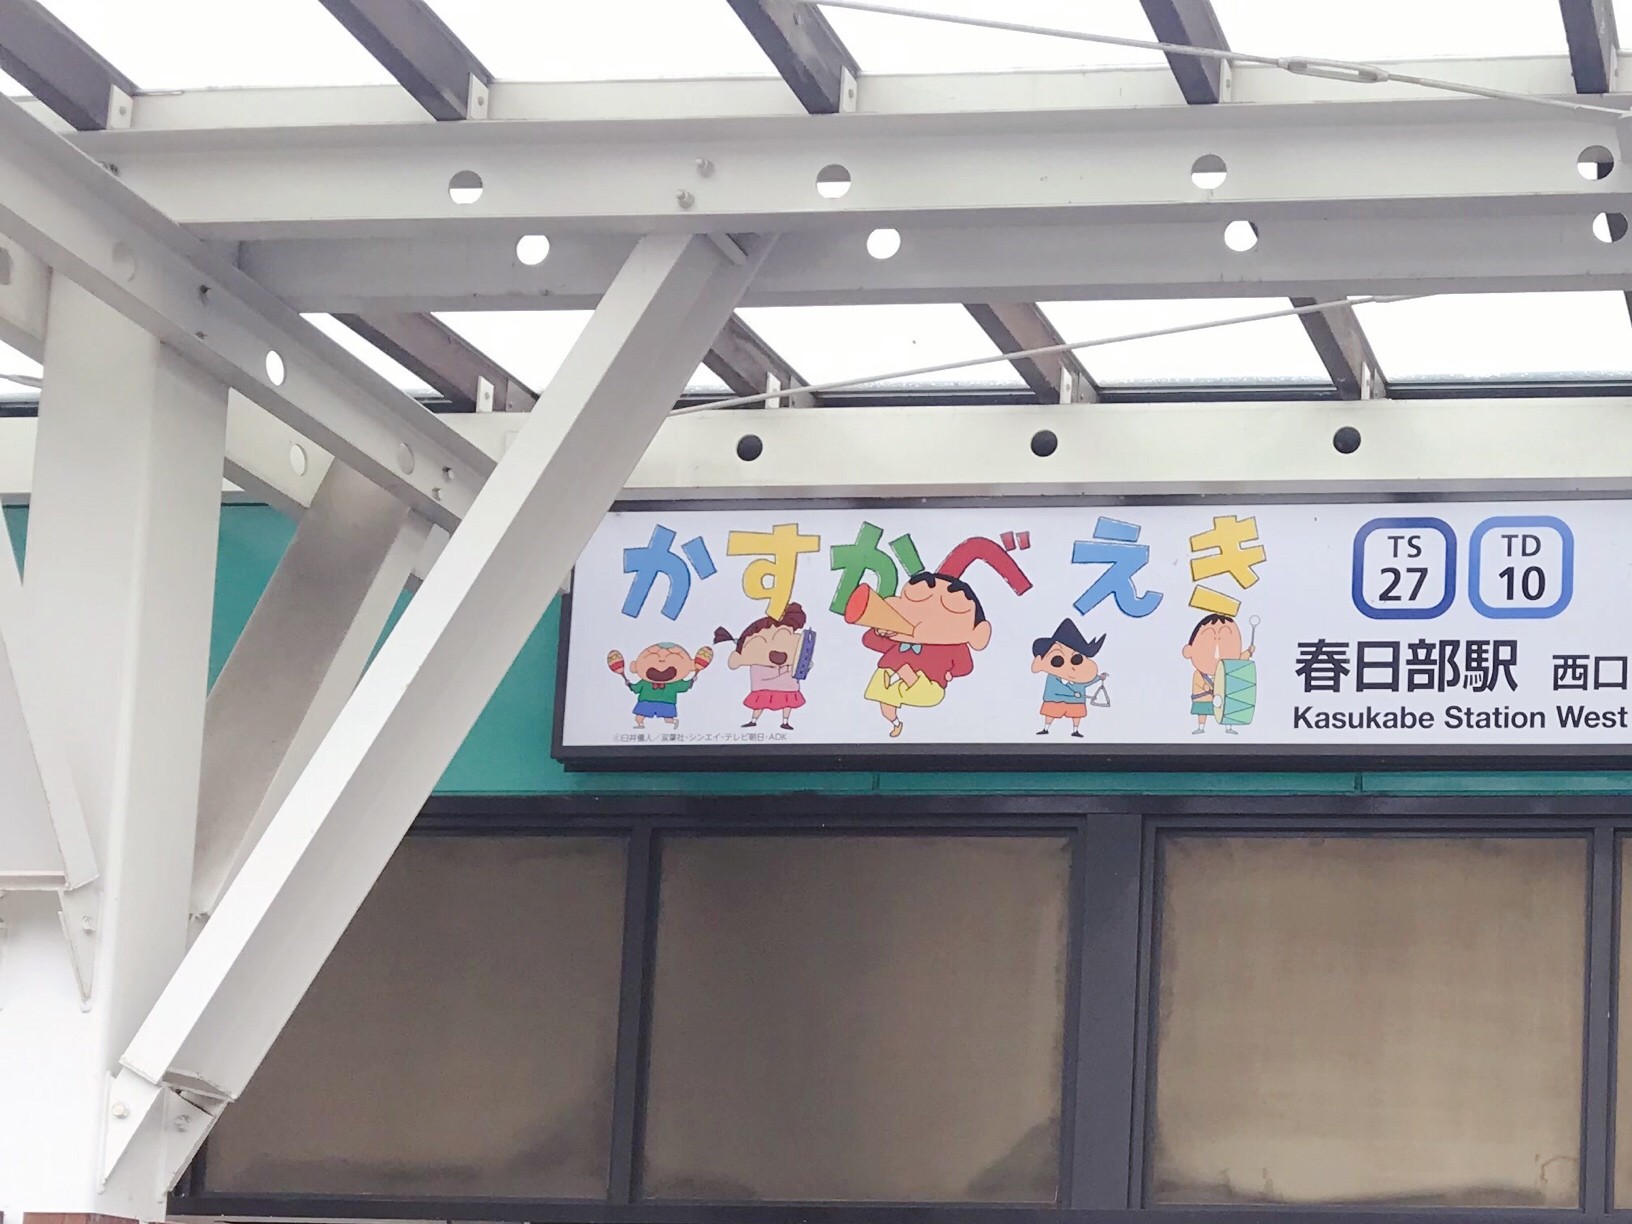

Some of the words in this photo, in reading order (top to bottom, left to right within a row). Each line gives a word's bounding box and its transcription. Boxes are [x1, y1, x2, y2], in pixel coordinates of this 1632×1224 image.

[1387, 535, 1422, 558] TS
[1501, 534, 1541, 557] TD
[1378, 567, 1428, 601] 27
[1499, 566, 1546, 601] 10
[1295, 638, 1518, 692] 春日部駅
[1553, 654, 1628, 690] 西口
[1294, 706, 1434, 729] Kasukabe
[1444, 705, 1545, 728] Station
[1556, 705, 1628, 728] West
